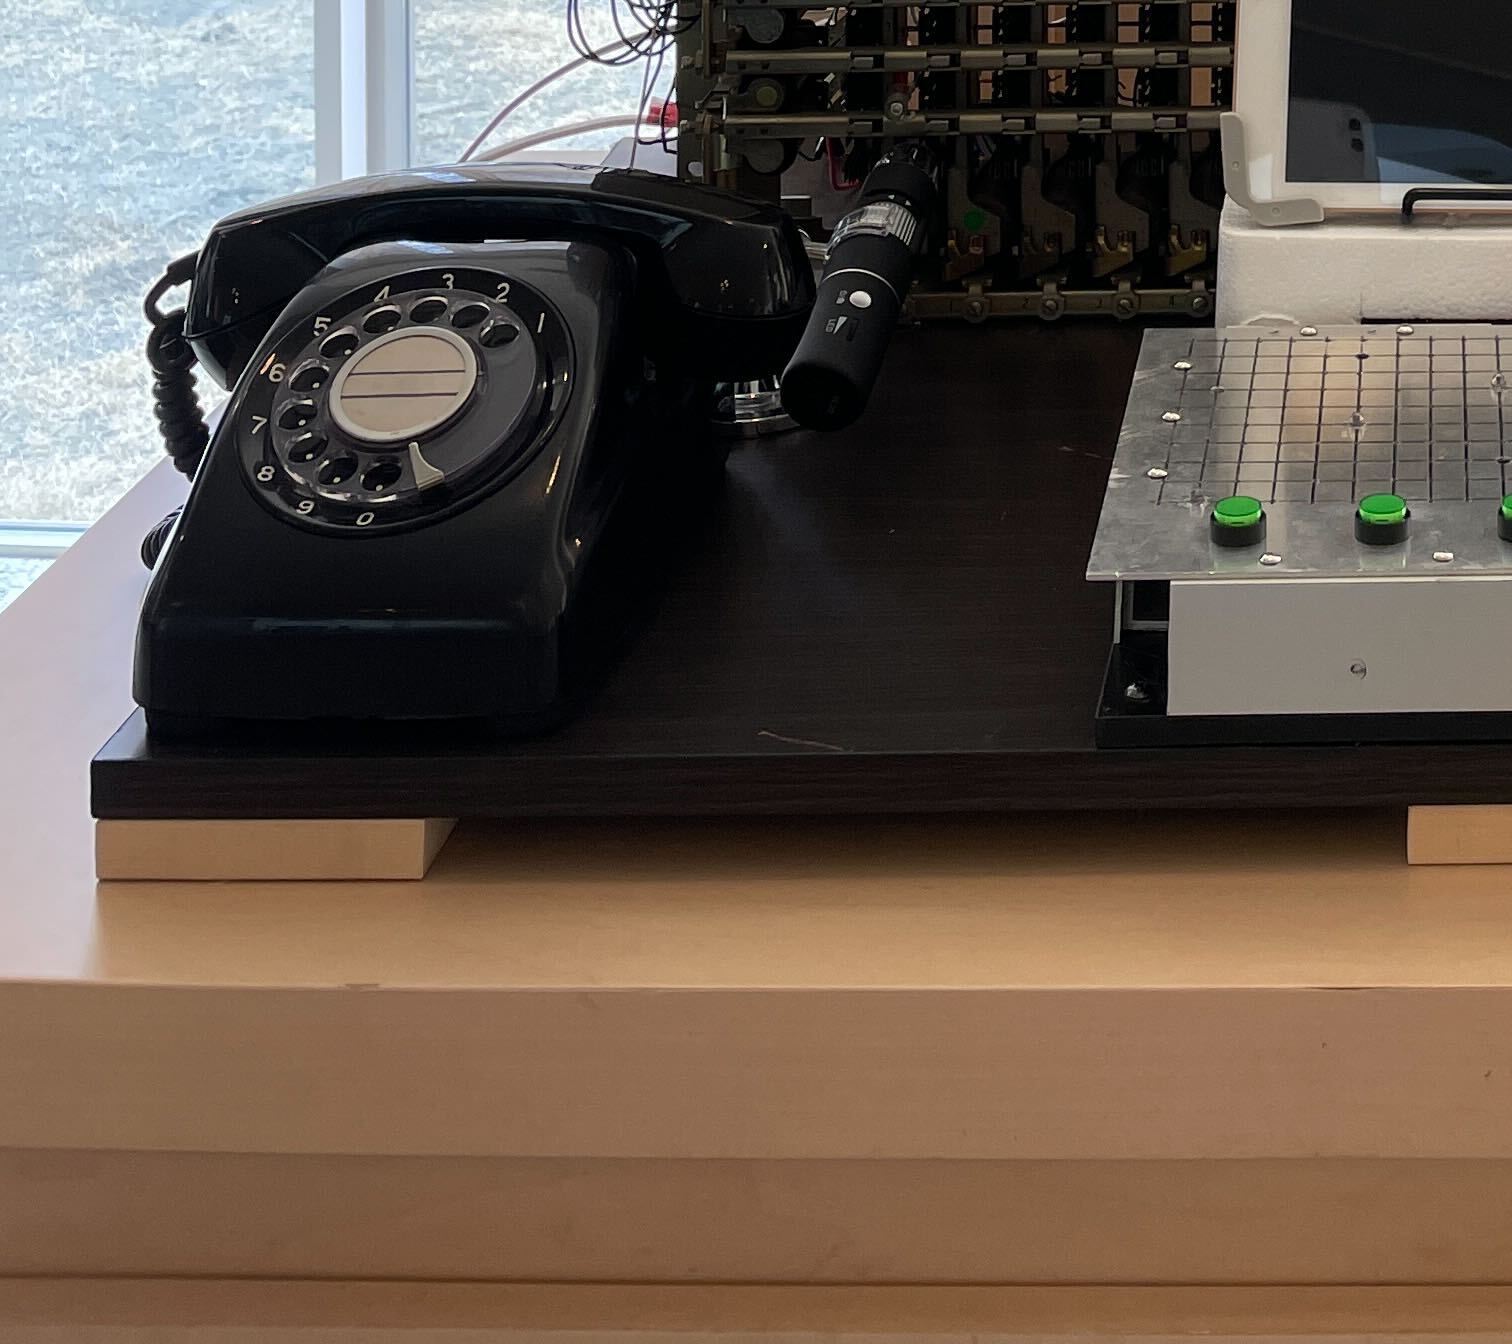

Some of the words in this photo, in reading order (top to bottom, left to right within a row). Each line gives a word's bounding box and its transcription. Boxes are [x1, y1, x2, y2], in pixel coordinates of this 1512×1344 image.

[442, 274, 454, 290] 3
[374, 286, 390, 303] 4
[496, 283, 510, 304] 2
[313, 317, 332, 336] 5
[537, 313, 544, 333] 1
[268, 363, 286, 382] 6
[251, 416, 268, 434] 7
[256, 466, 275, 482] 8
[297, 500, 314, 515] 9
[356, 512, 374, 526] 0
